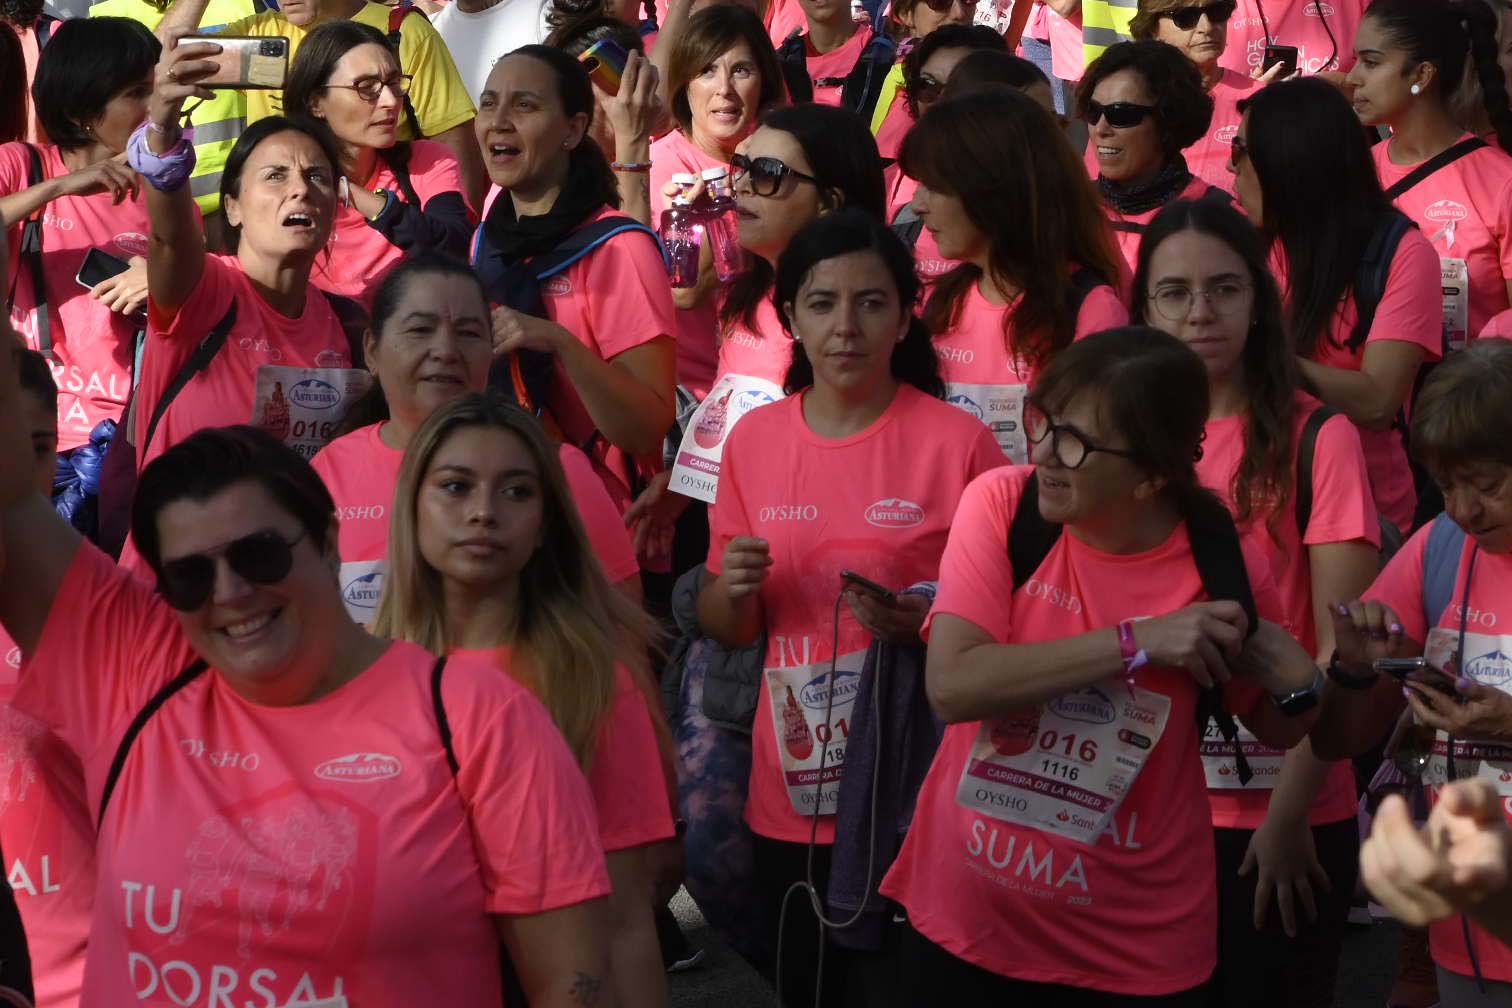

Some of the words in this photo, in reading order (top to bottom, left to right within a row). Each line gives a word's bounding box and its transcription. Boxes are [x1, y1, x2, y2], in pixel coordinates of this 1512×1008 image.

[292, 419, 332, 438] 016
[759, 504, 818, 523] OYSHO
[1040, 729, 1099, 764] 016
[320, 762, 398, 780] ASTURIANA
[1040, 758, 1080, 782] 1116
[974, 787, 1028, 814] OYSHO
[986, 765, 1033, 789] CARRERA
[1065, 784, 1103, 807] MUJER
[965, 817, 1090, 894] SUMA
[119, 881, 183, 935] TU
[129, 951, 349, 1008] DORSAL
